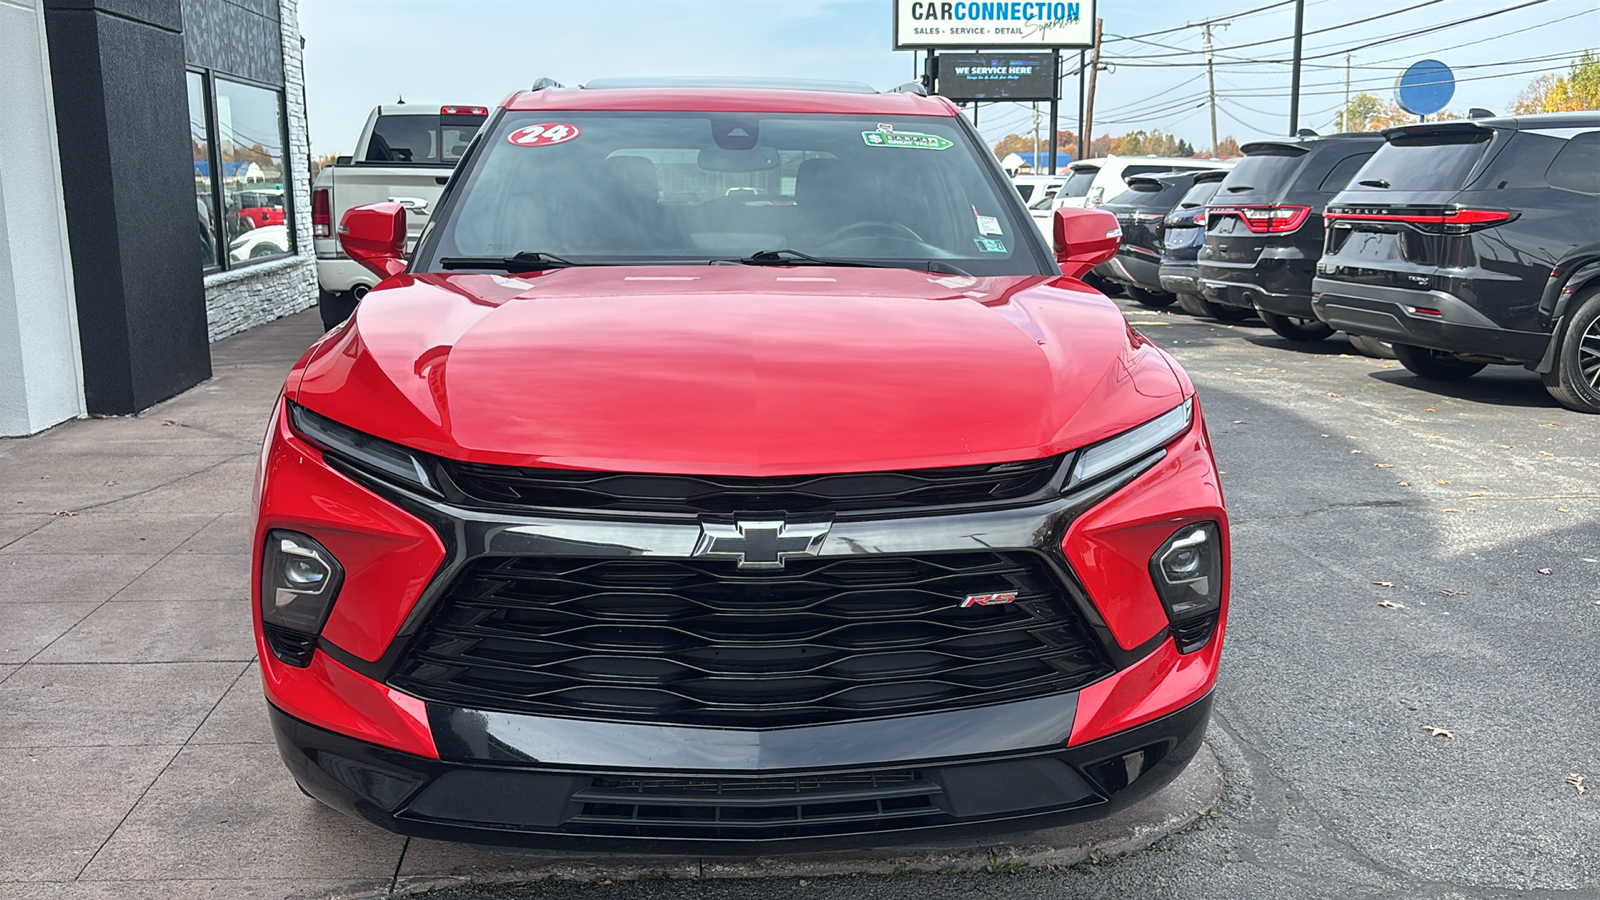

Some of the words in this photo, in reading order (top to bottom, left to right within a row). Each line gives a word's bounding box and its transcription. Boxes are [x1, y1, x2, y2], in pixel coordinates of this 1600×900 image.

[914, 27, 940, 35] SALES
[950, 27, 985, 35] SERVICE
[994, 27, 1023, 35] DETAIL
[955, 66, 970, 74] WE
[971, 66, 1007, 74] SERVICE
[1008, 66, 1033, 74] HERE
[516, 125, 570, 143] 24
[960, 592, 1018, 608] RS
